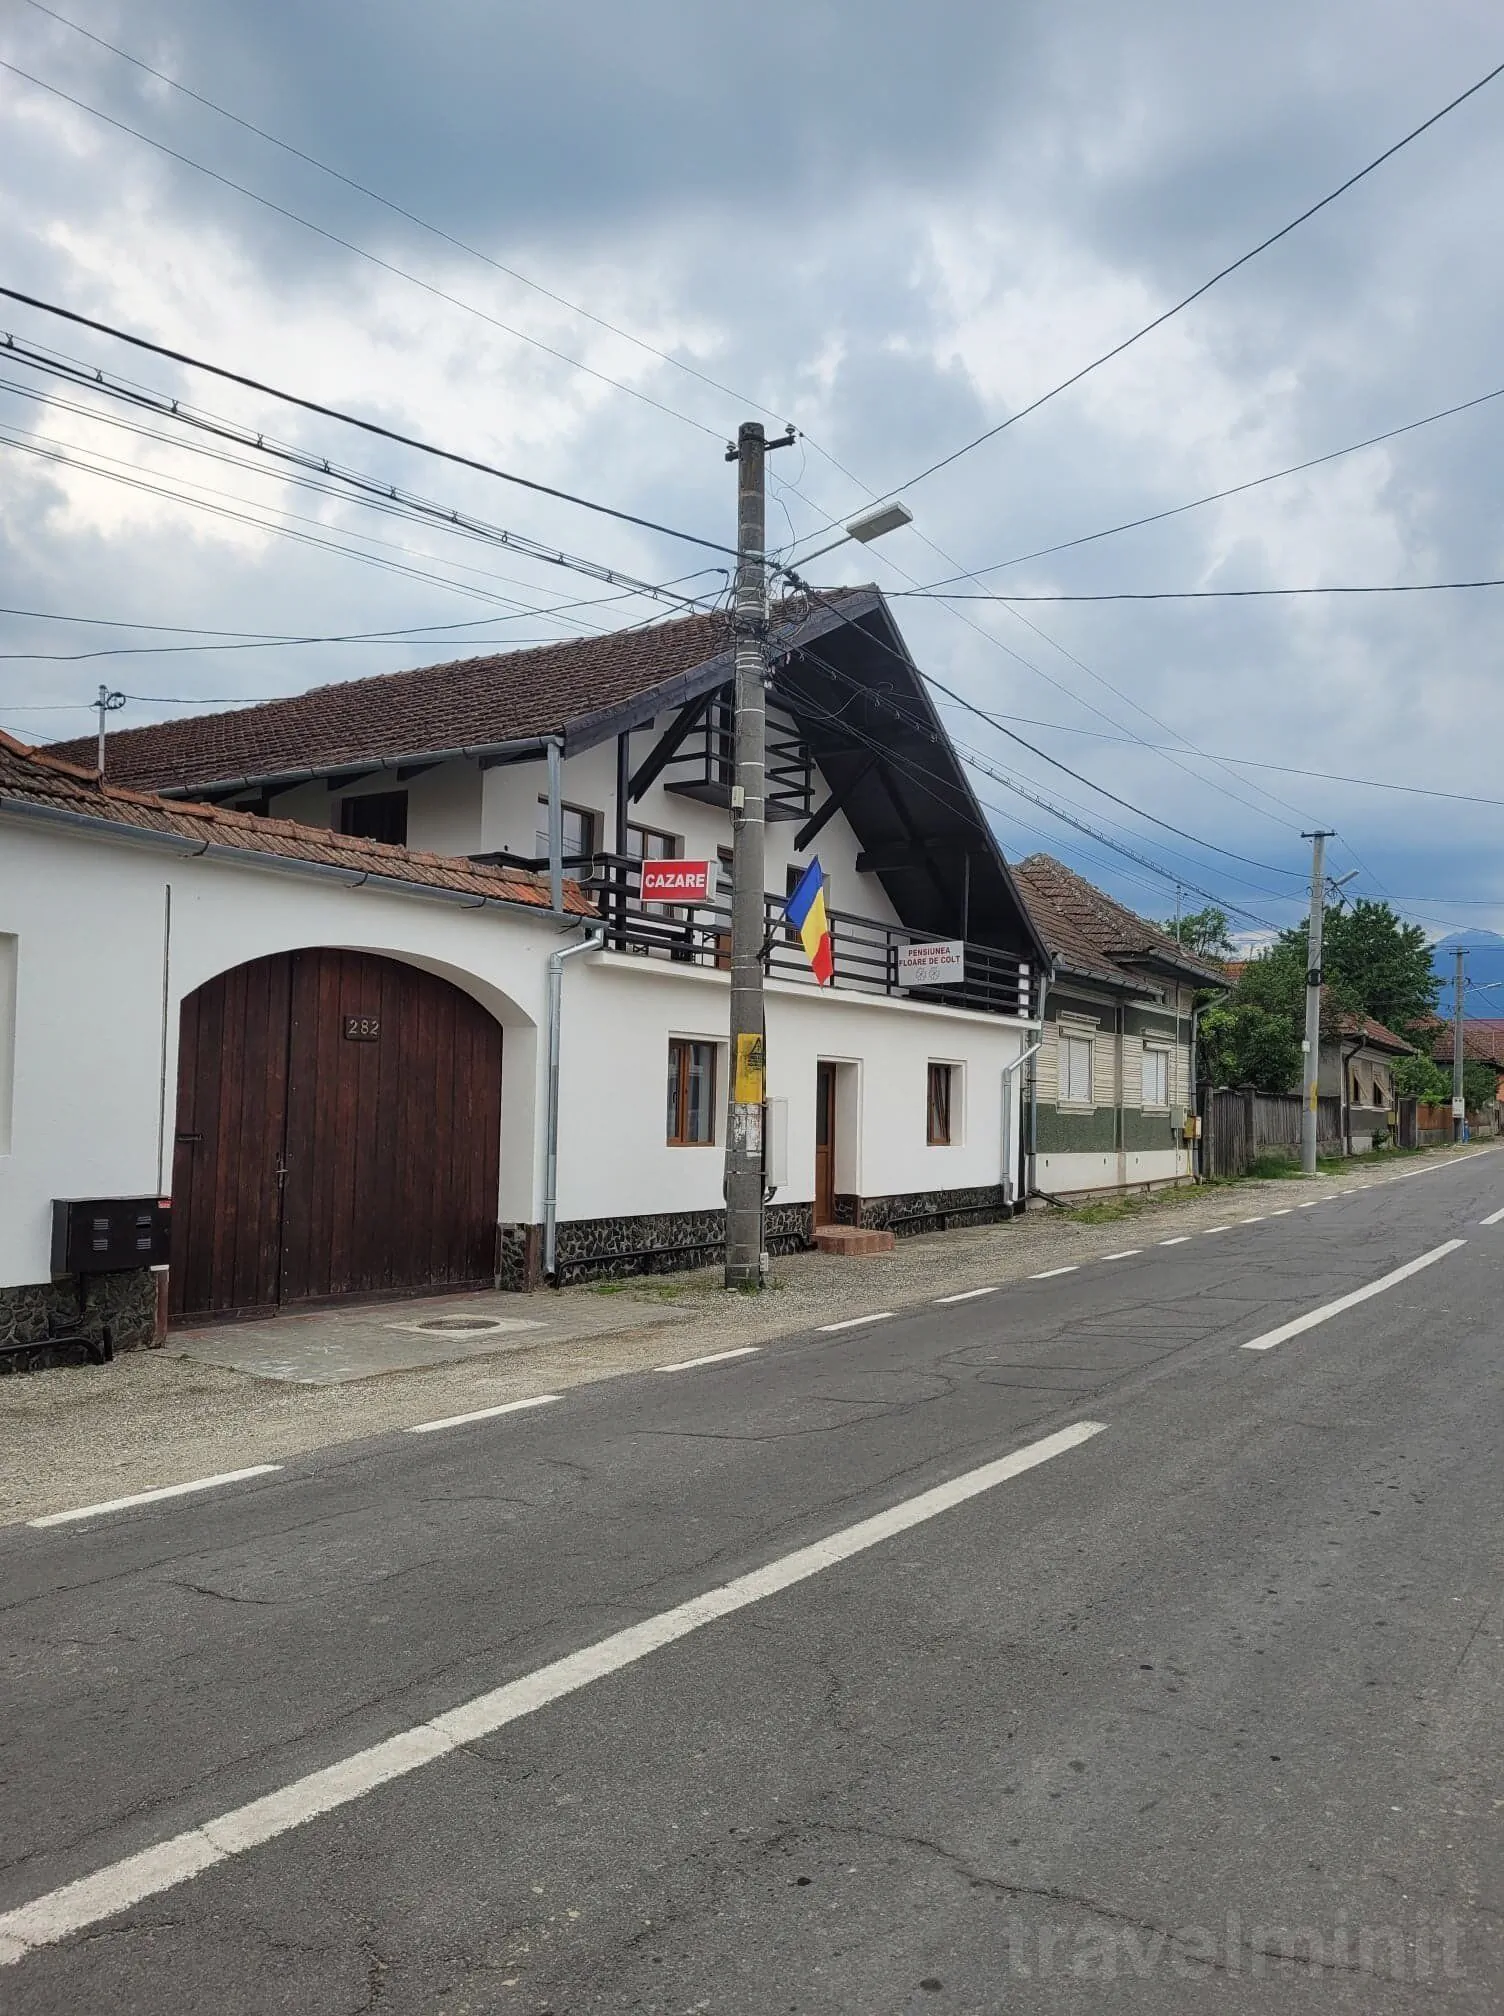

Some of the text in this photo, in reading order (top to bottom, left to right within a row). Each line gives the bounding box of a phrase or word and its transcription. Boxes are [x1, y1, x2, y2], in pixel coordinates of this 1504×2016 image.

[645, 873, 705, 888] CAZARE
[908, 946, 951, 957] PENSIUNEA
[898, 957, 927, 967] FLOARE
[929, 957, 939, 965] DE
[348, 1019, 379, 1035] 282
